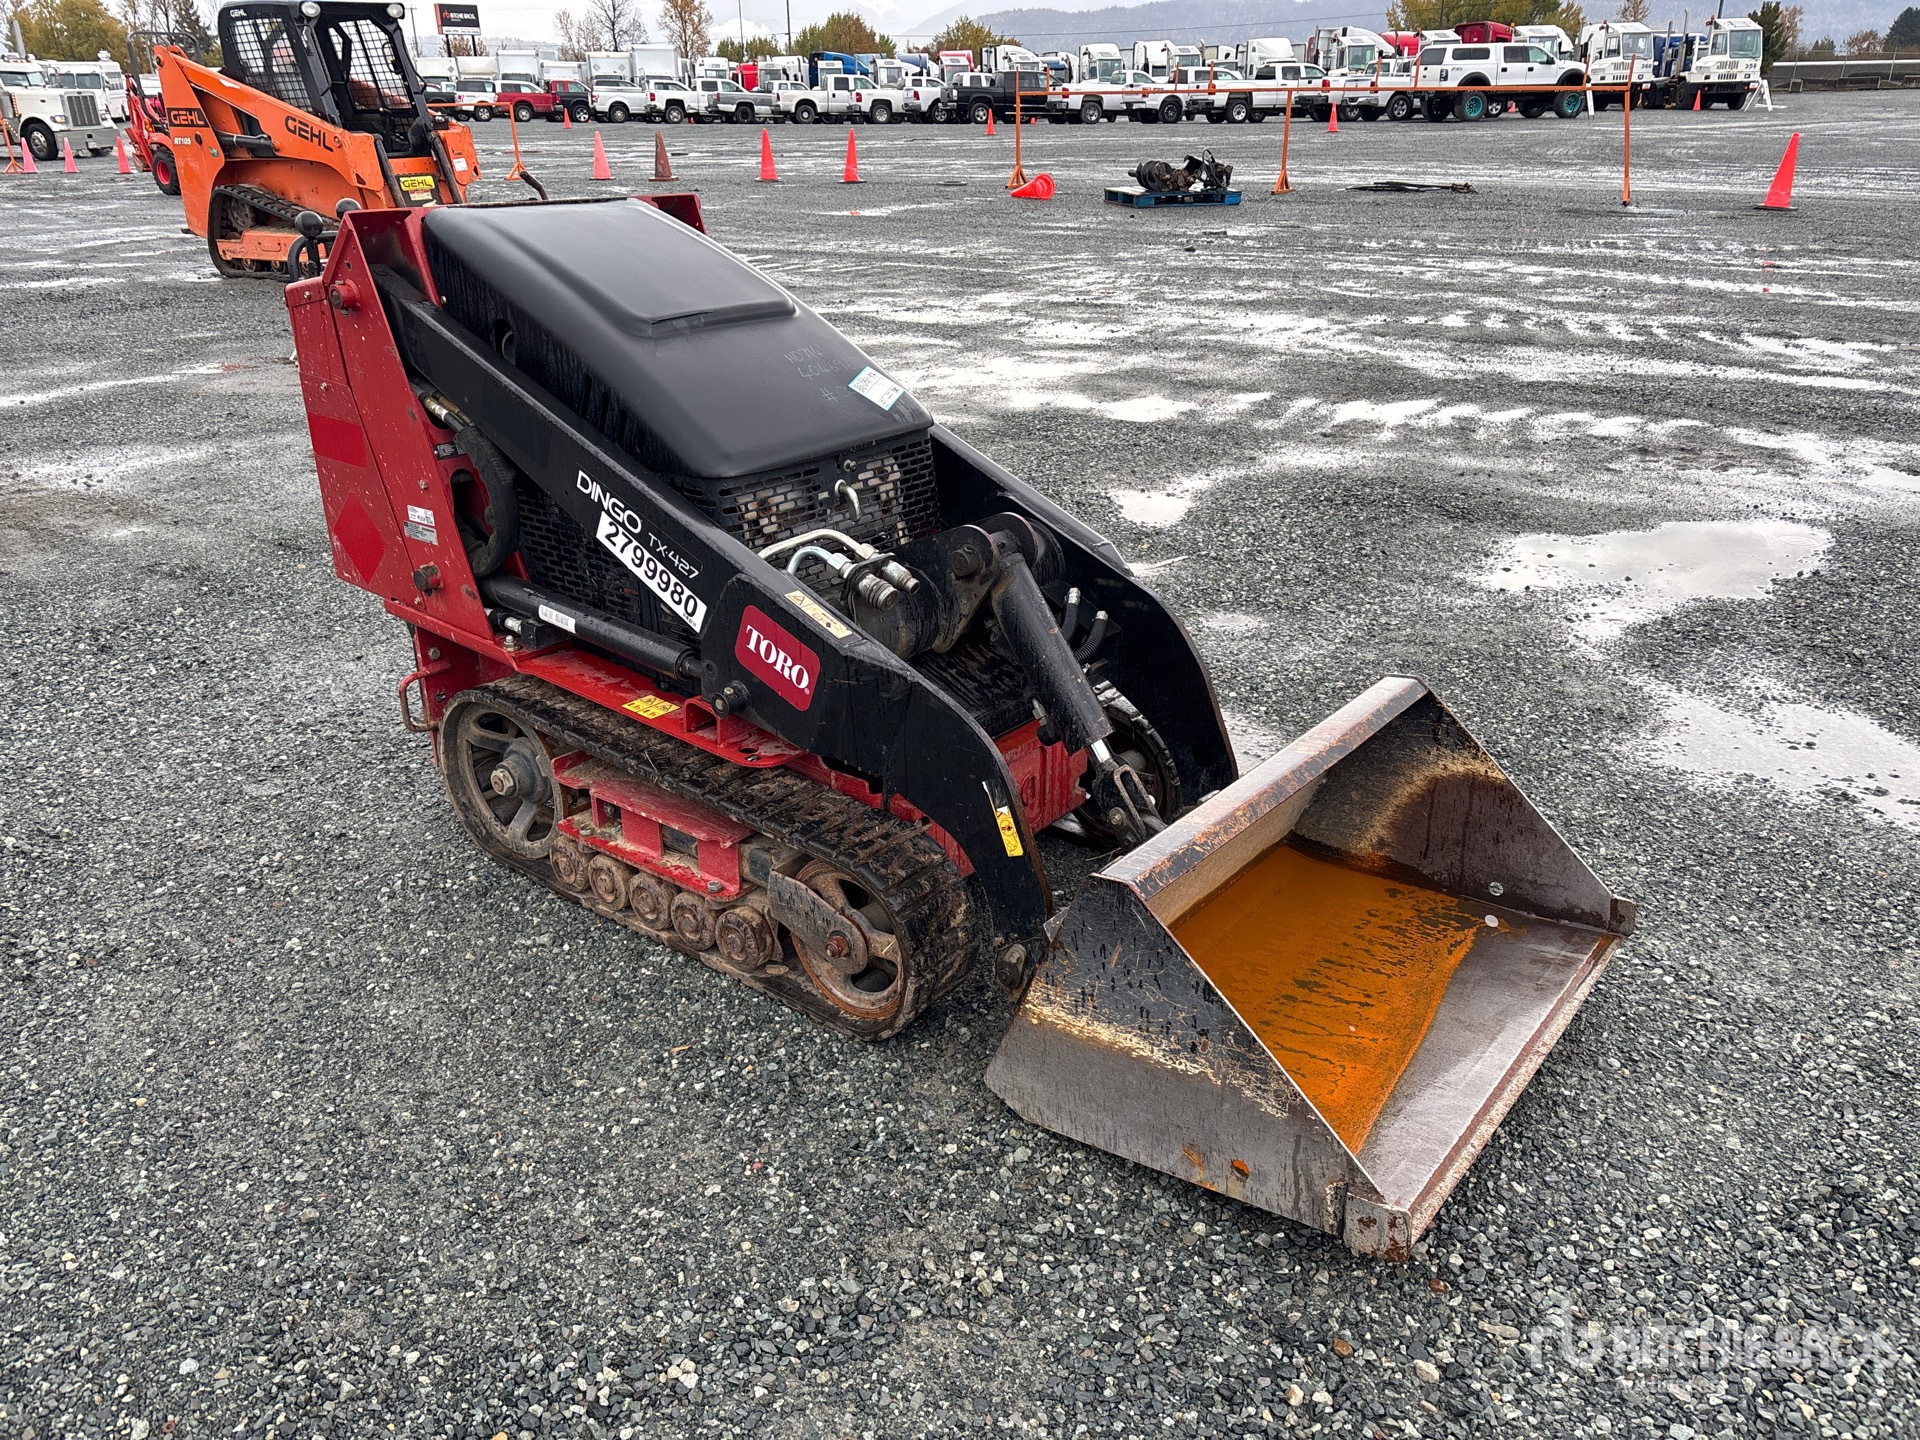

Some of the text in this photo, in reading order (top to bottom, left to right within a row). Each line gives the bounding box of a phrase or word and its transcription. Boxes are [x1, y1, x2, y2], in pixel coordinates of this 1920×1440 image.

[170, 110, 205, 125] GEHL
[285, 115, 334, 153] GEHL
[174, 137, 191, 145] RT105
[402, 178, 433, 188] GEHL
[576, 469, 642, 534] DINGO
[604, 521, 698, 618] 2799980
[745, 624, 810, 689] TORO
